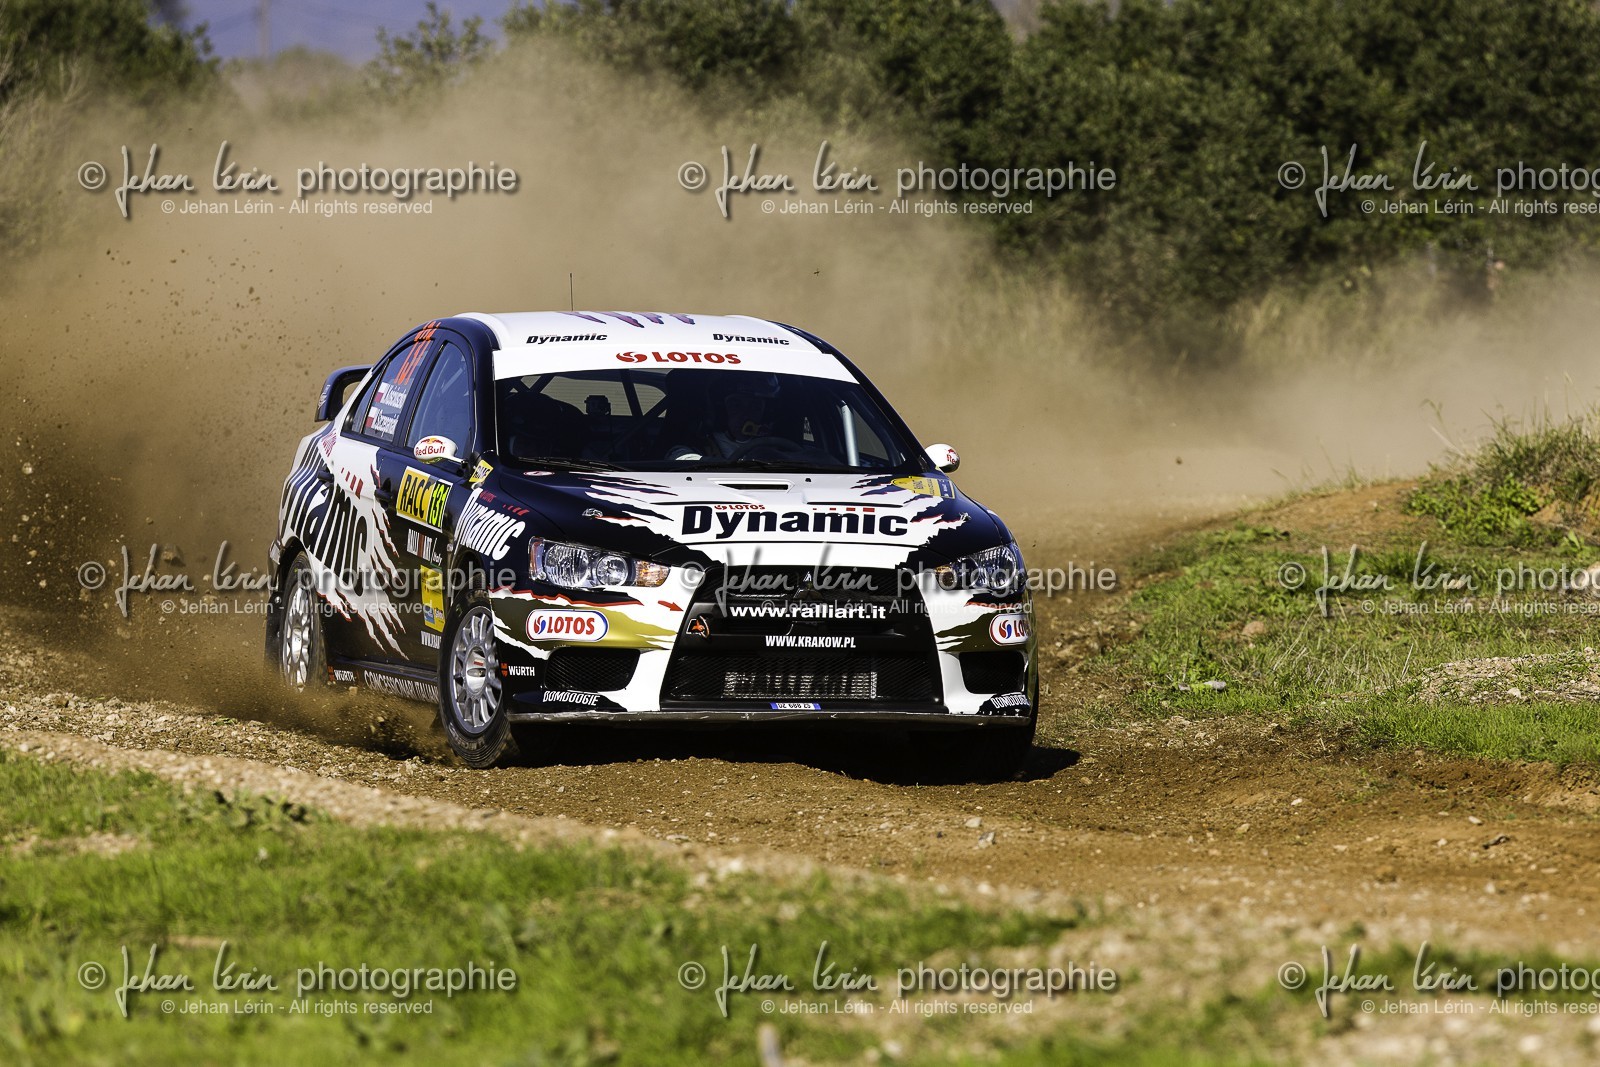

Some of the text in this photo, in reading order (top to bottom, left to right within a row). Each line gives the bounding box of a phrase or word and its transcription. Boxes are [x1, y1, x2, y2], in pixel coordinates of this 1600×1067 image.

[525, 333, 608, 345] Dynamic
[713, 333, 790, 346] Dynamic
[652, 351, 742, 365] LOTOS
[399, 474, 433, 519] RACC
[427, 483, 451, 528] 131
[681, 504, 908, 540] Dynamic
[729, 604, 886, 619] www.ralliart.it
[547, 616, 595, 635] LOTOS
[765, 635, 857, 649] WWW.KRAKOW.PL
